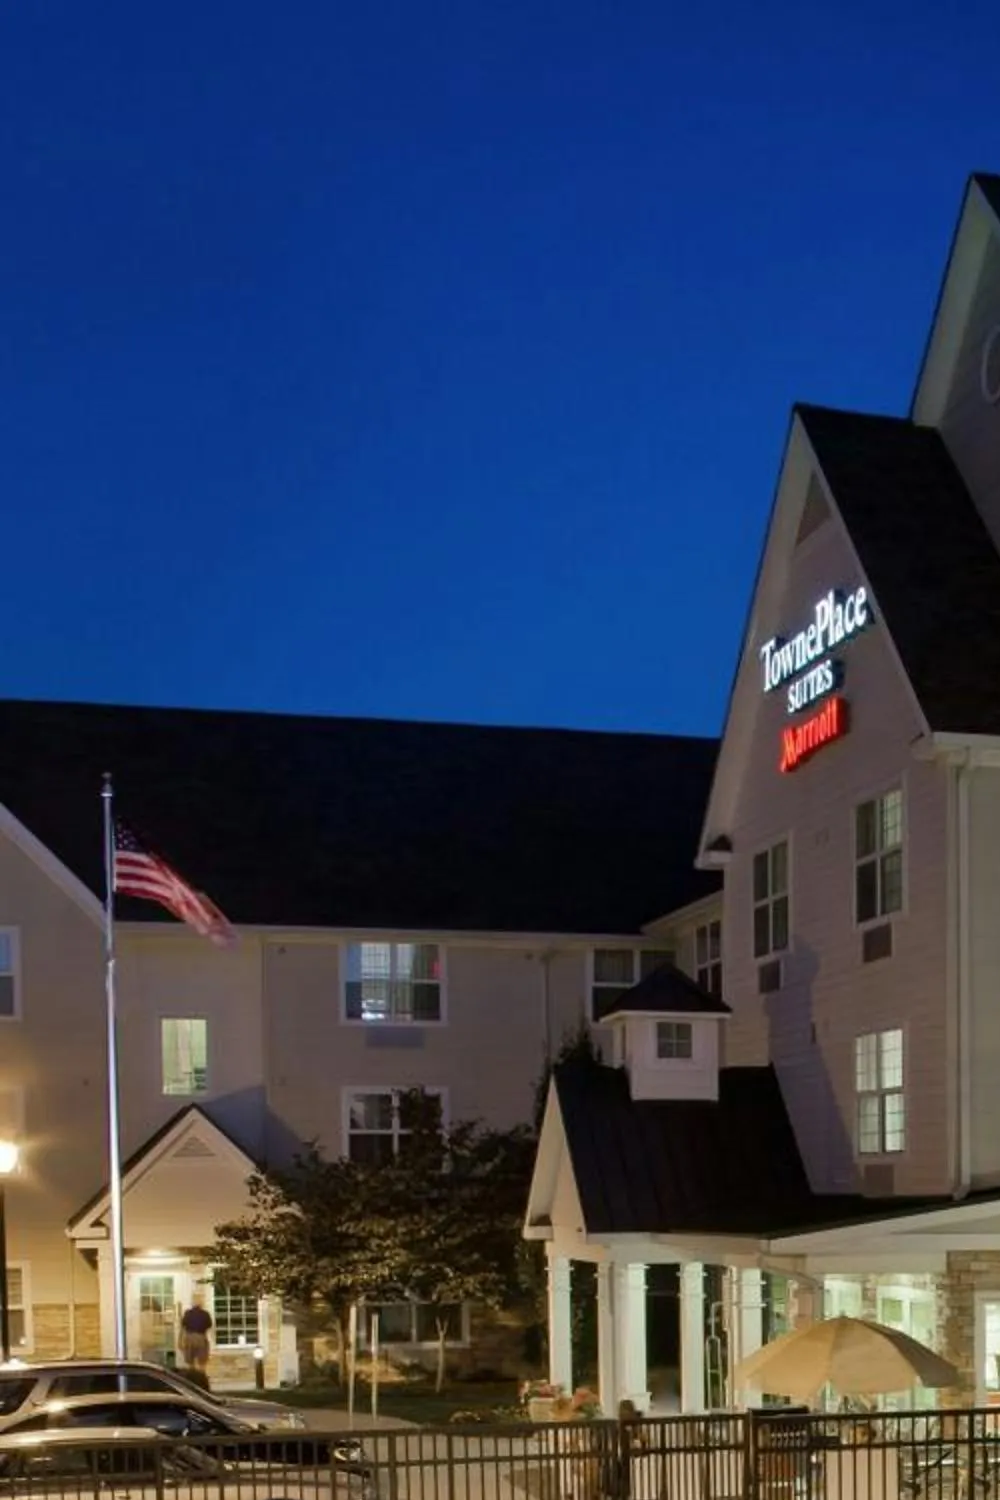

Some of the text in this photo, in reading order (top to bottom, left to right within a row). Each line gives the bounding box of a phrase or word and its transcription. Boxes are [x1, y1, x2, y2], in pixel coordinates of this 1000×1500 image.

[760, 586, 867, 692] TownePlace
[787, 659, 834, 712] SUITES
[780, 697, 838, 773] Marriott
